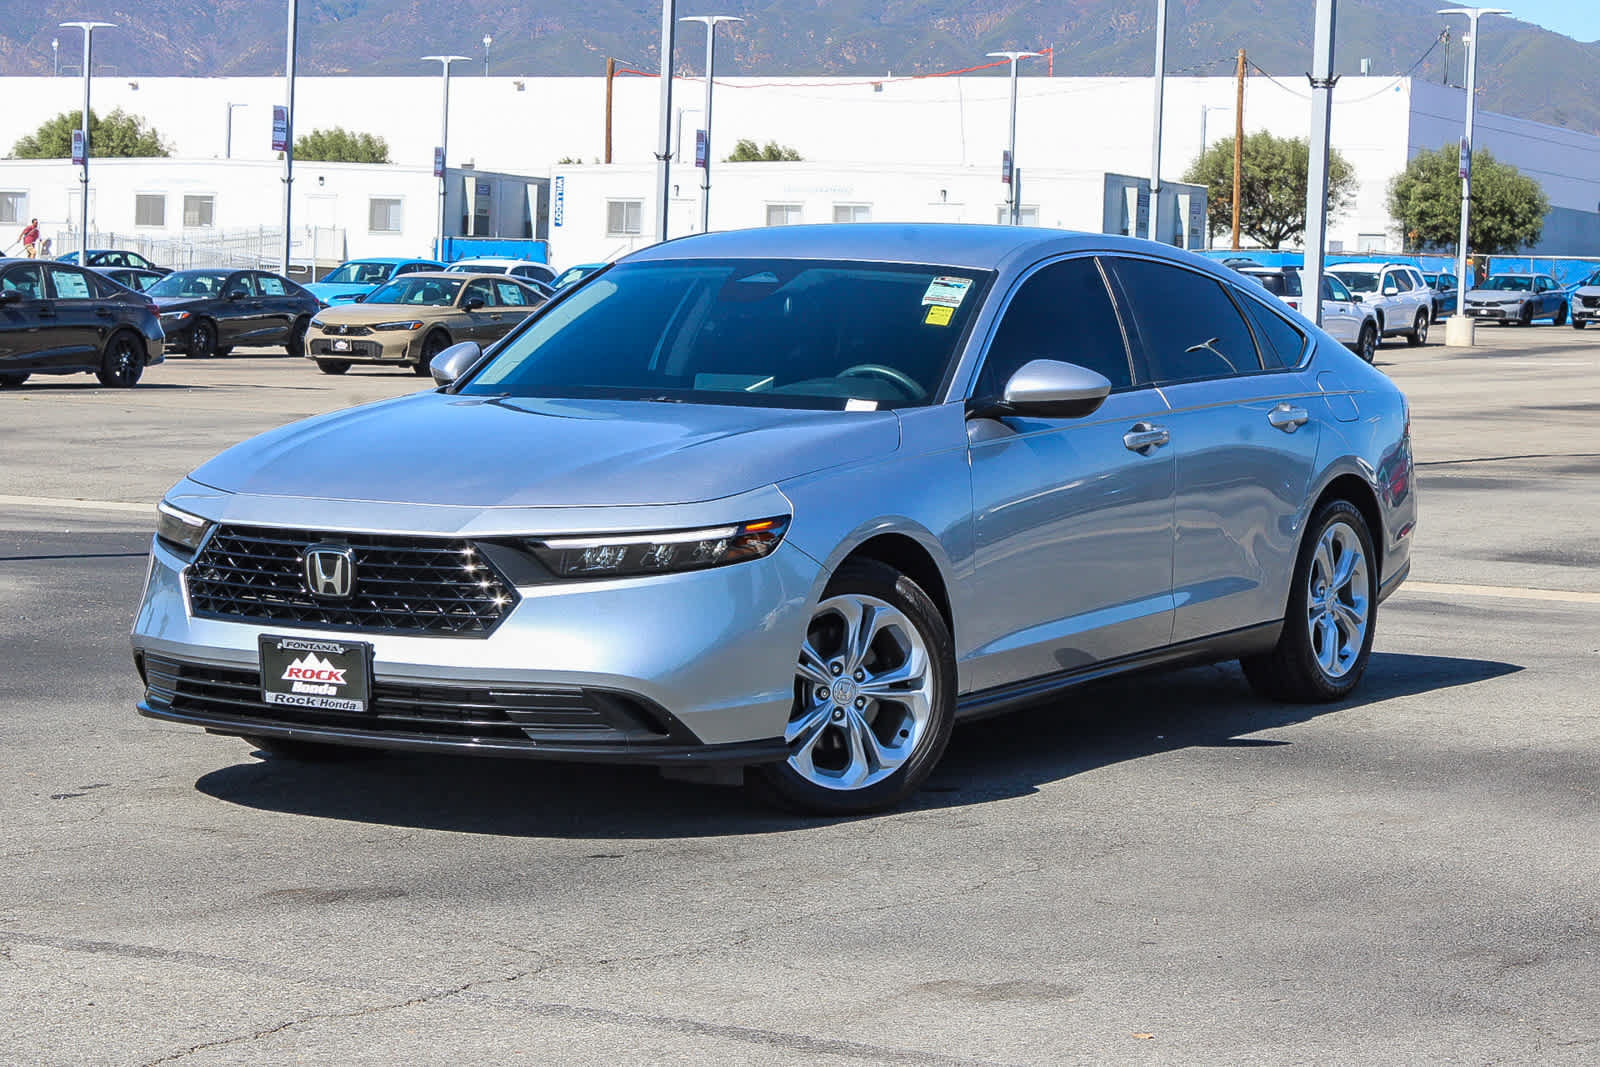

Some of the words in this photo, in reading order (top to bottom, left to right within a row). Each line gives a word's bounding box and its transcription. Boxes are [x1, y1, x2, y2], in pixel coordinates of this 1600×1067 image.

[555, 176, 564, 226] WILLSCOT
[286, 641, 338, 651] FONTANA
[287, 667, 341, 681] ROCK
[274, 694, 317, 706] Rock
[320, 698, 357, 710] Honda
